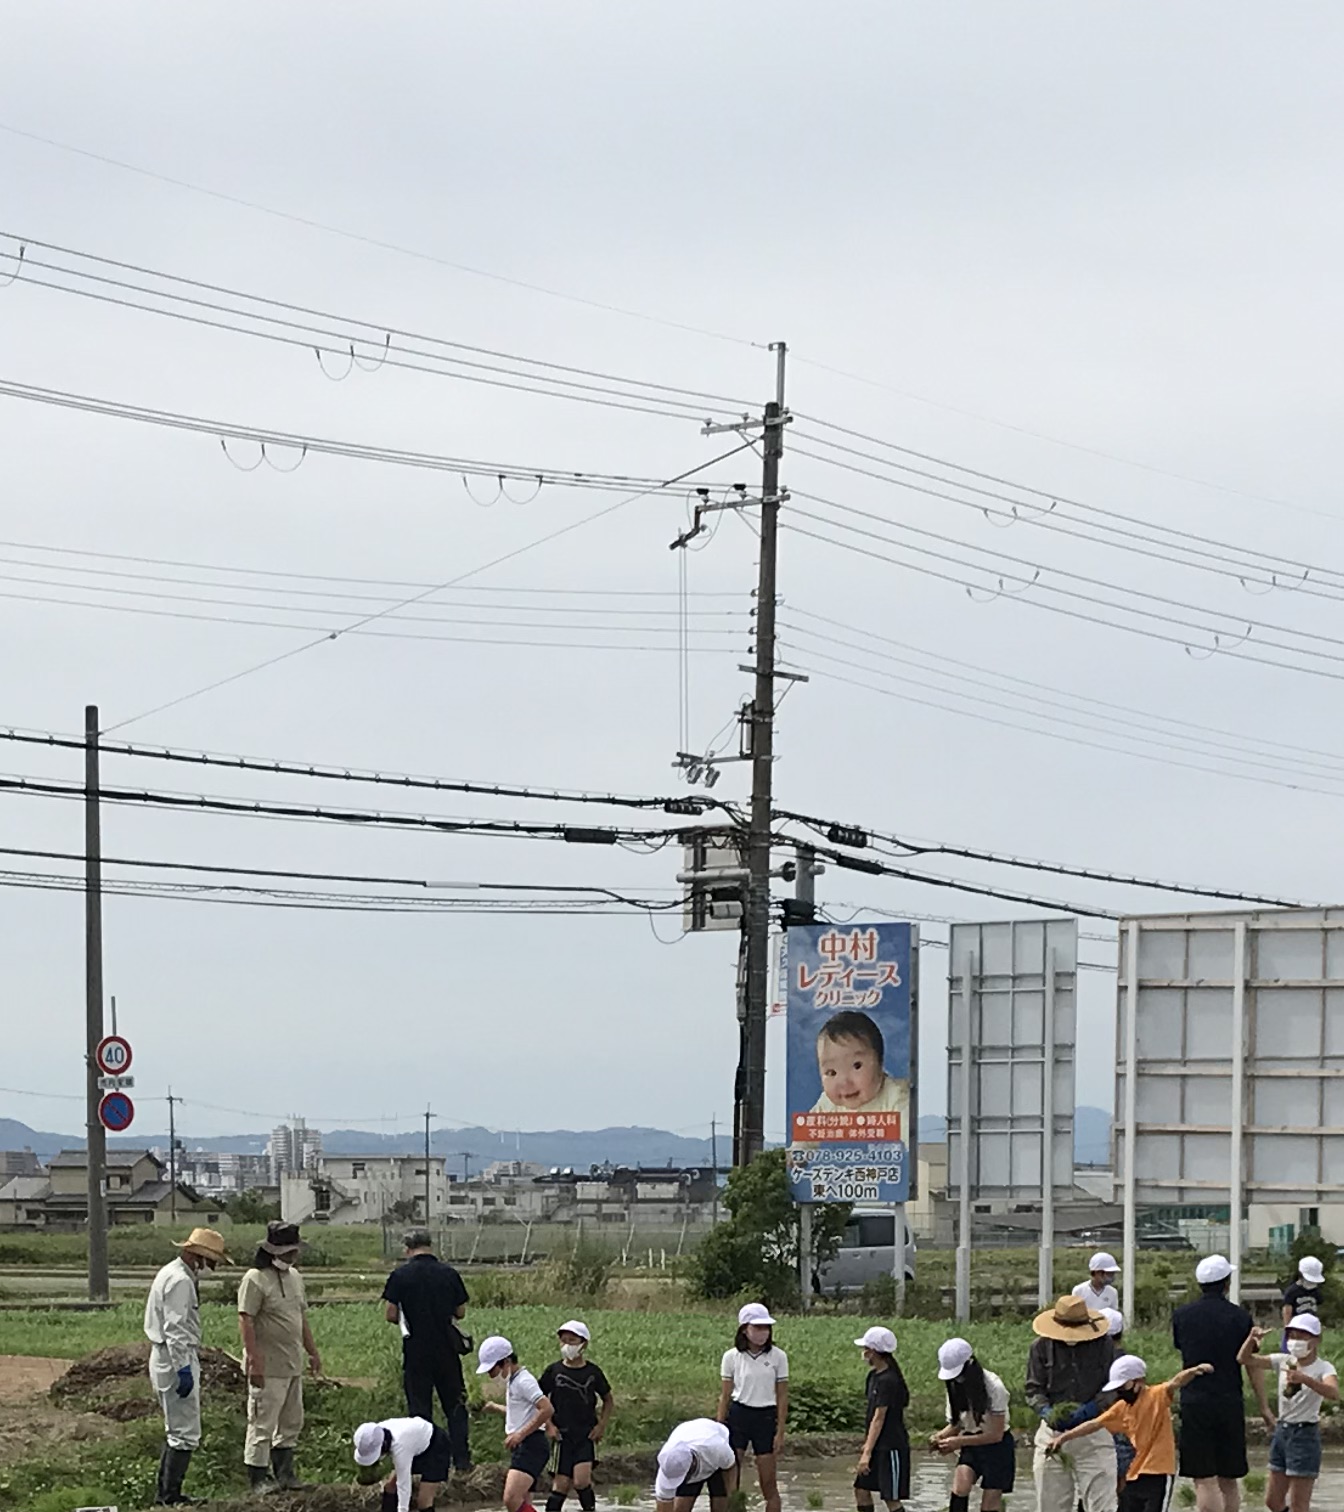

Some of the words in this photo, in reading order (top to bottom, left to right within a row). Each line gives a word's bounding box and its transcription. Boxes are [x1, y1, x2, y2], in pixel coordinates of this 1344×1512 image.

[820, 931, 877, 961] 中村
[799, 964, 900, 989] レディース
[815, 989, 881, 1007] クリニック
[105, 1046, 125, 1064] 40
